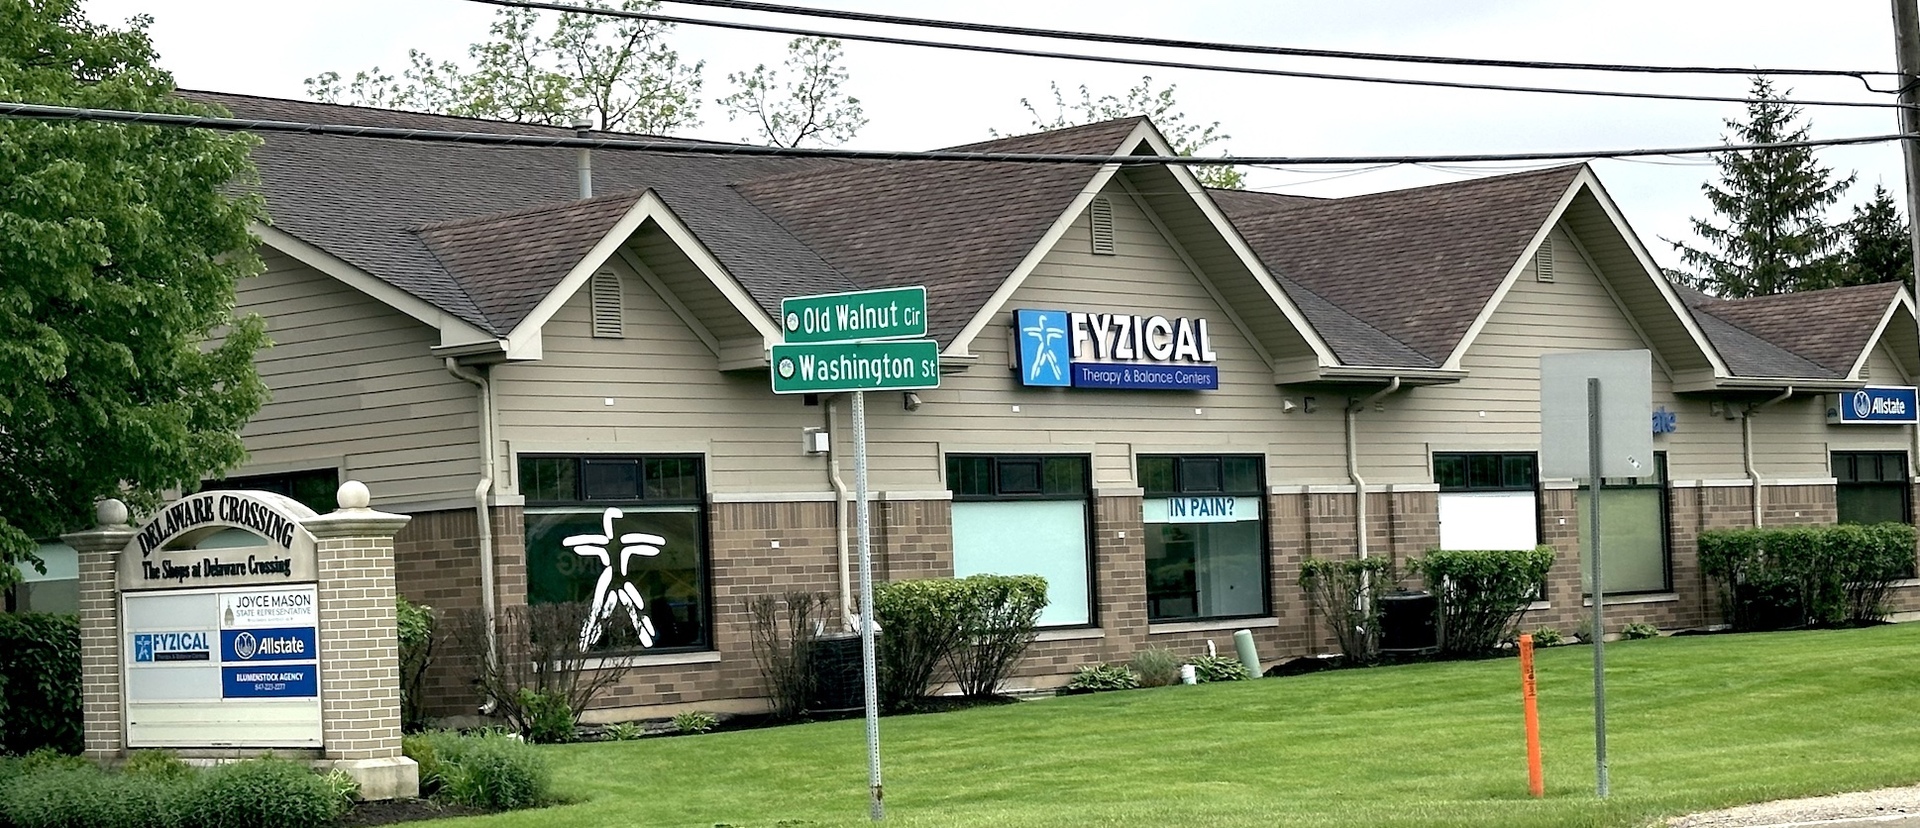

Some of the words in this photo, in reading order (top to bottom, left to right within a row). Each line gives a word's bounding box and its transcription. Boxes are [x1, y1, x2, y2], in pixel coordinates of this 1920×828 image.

[803, 306, 830, 334] Old
[835, 301, 898, 331] Walnut
[903, 307, 921, 326] Cir
[1069, 312, 1217, 362] FYZICAL
[799, 353, 915, 385] Washington
[921, 359, 936, 377] St
[1082, 368, 1122, 385] Therapy
[1124, 370, 1131, 382] &
[1133, 369, 1173, 384] Balance
[1174, 371, 1212, 385] Centers
[1871, 397, 1906, 415] Allstate
[1169, 497, 1186, 517] IN
[1190, 497, 1235, 517] PAIN?
[136, 495, 215, 557] DELAWARE
[219, 495, 295, 549] CROSSING
[142, 561, 160, 579] The
[162, 559, 190, 583] Shops
[191, 562, 201, 577] at
[203, 557, 247, 577] Delaware
[248, 555, 292, 577] Crossing
[236, 595, 269, 609] JOYCE
[271, 594, 311, 607] MASON
[236, 608, 256, 617] STATE
[257, 607, 311, 617] REPRESENTATIVE
[153, 632, 210, 651] FYZICAL
[258, 636, 304, 655] Allstate
[279, 672, 304, 681] AGENCY
